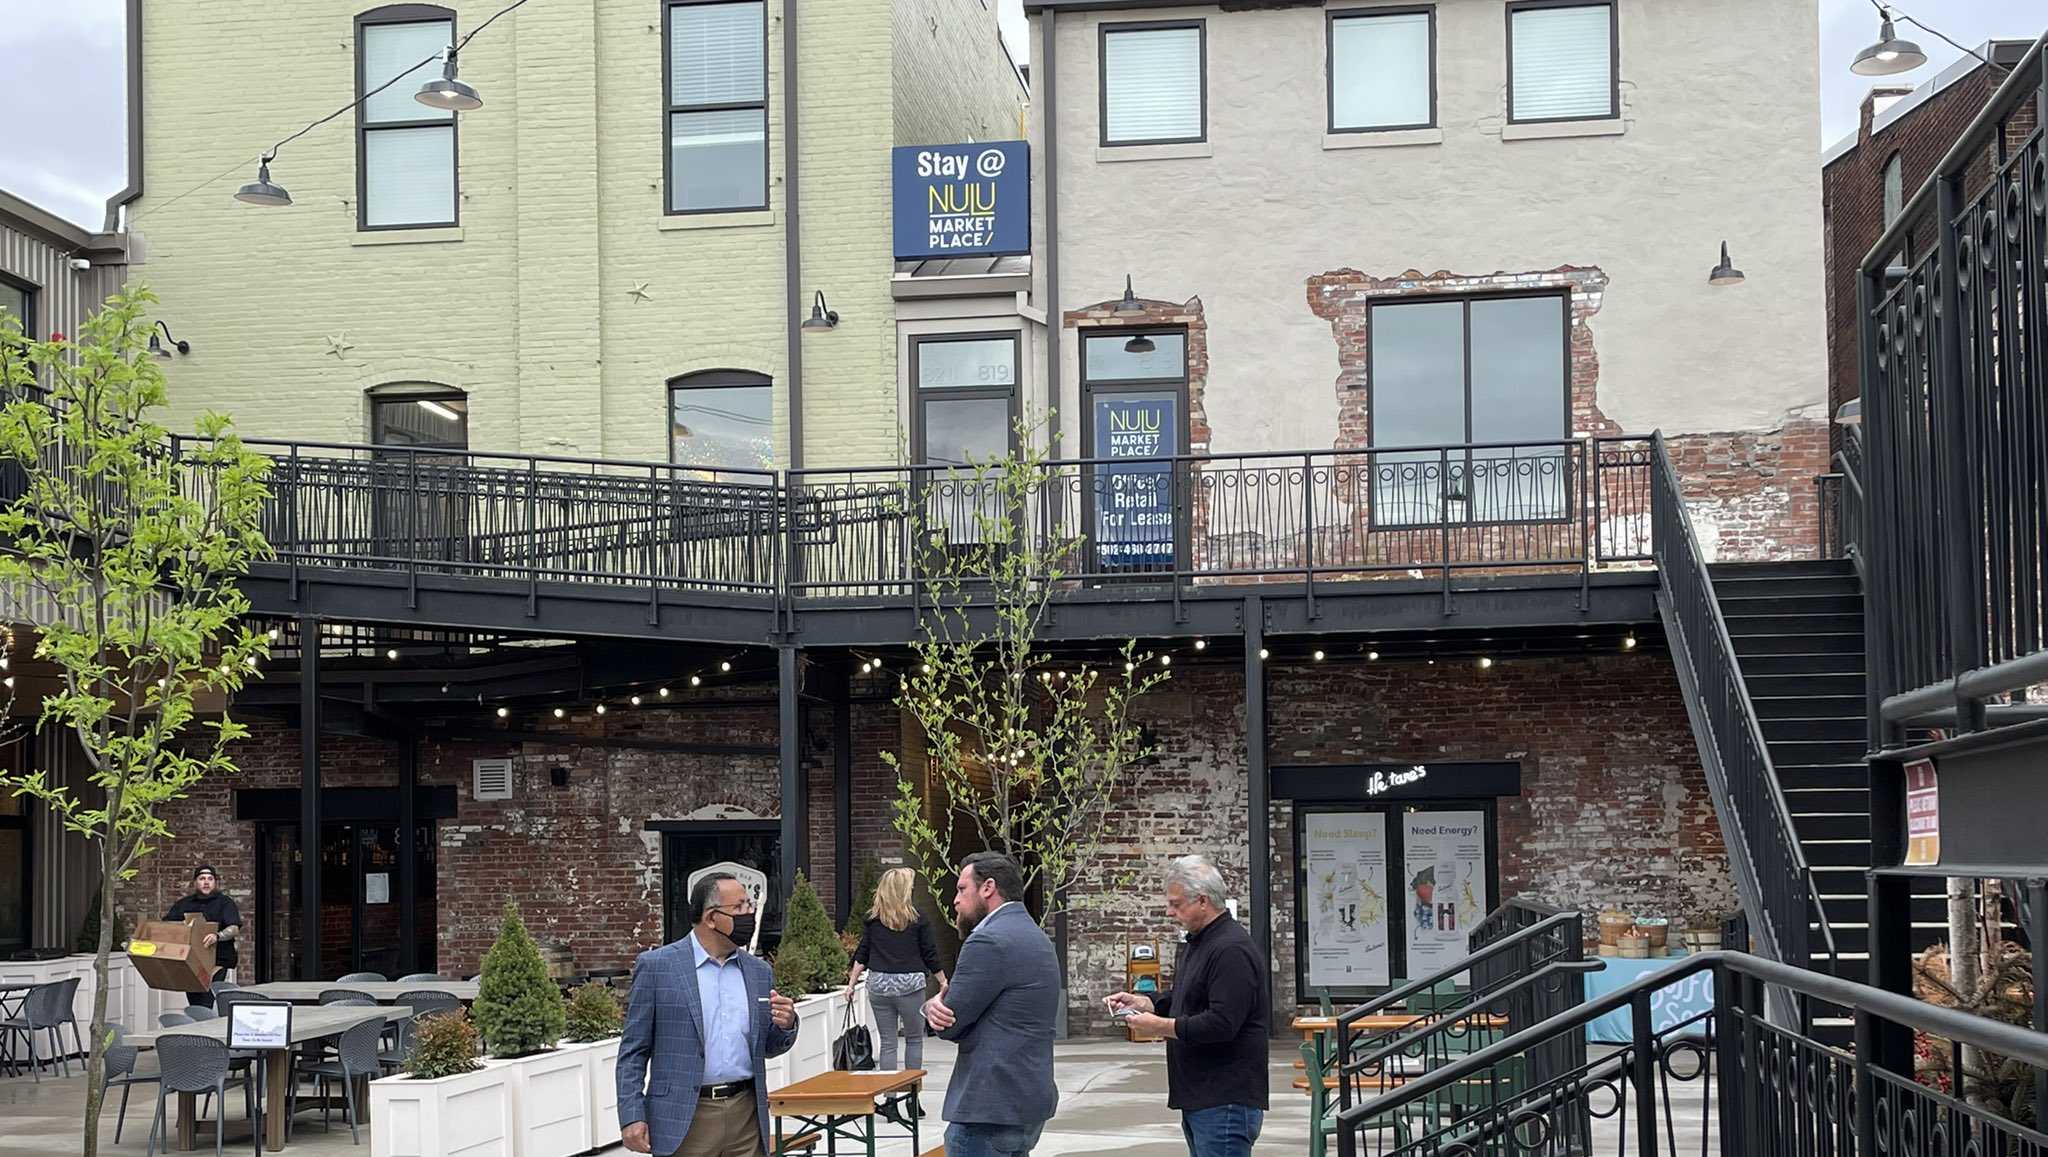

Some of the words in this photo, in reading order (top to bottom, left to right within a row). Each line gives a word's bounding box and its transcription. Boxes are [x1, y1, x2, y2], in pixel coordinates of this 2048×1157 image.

[918, 152, 969, 180] Stay
[976, 149, 1006, 178] @
[929, 182, 995, 216] NULU
[929, 217, 995, 233] MARKET
[929, 232, 994, 248] PLACE/
[1110, 409, 1160, 433] NULU
[1111, 434, 1160, 446] MARKET
[1411, 825, 1437, 836] Need
[1439, 825, 1479, 836] Energy?
